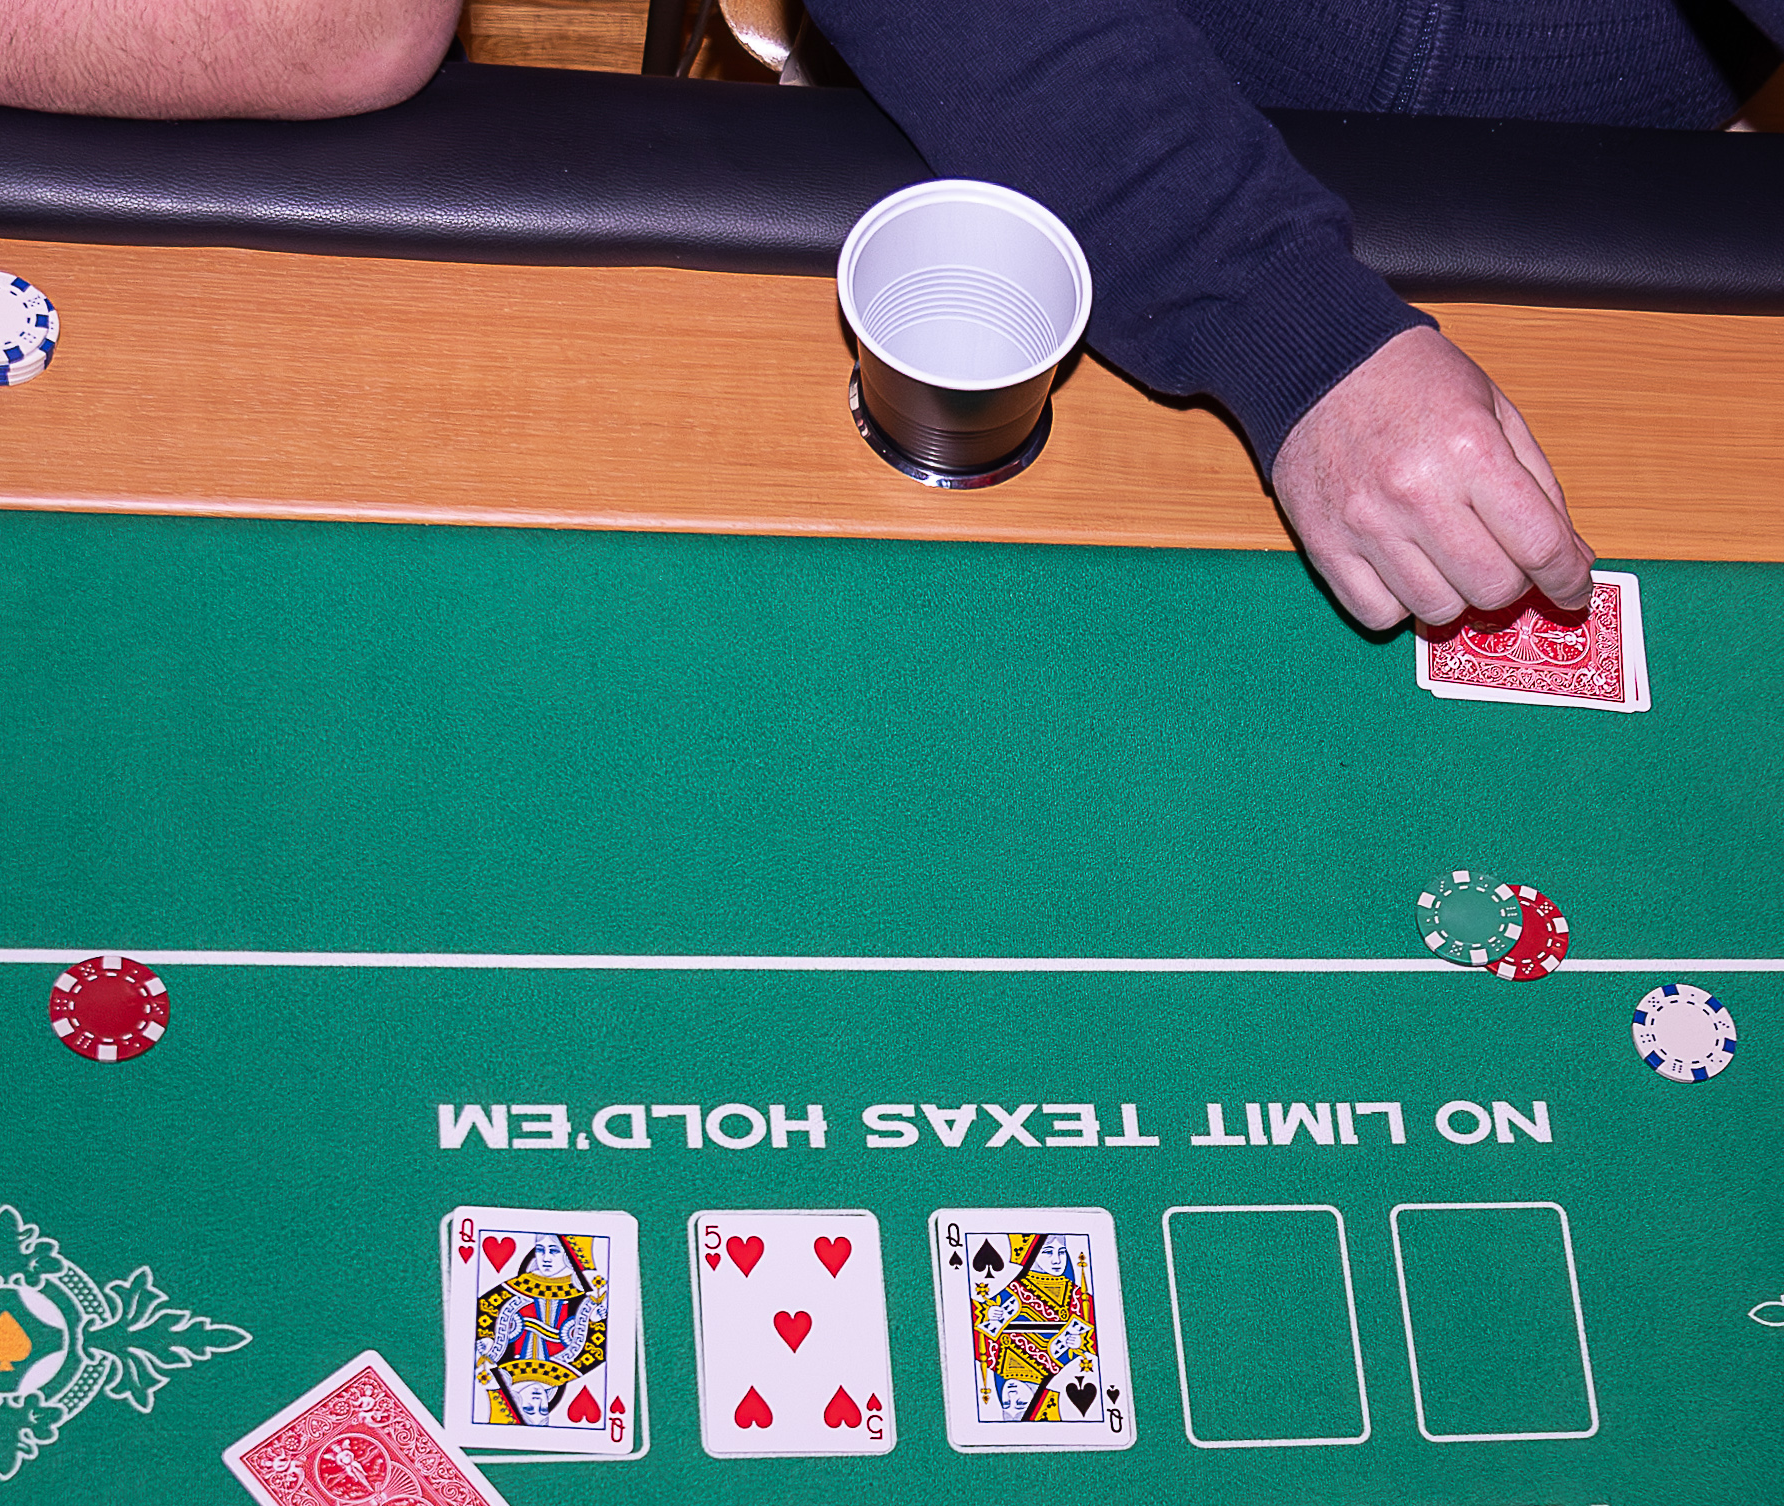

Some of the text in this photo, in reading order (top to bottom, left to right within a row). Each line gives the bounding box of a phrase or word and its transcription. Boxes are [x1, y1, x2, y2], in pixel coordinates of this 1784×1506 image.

[437, 1100, 1553, 1150] NO LIMIT TEXAS HOLD'EM
[459, 1218, 475, 1243] Q
[705, 1225, 722, 1250] 5
[946, 1223, 963, 1248] Q
[609, 1417, 625, 1443] Q
[866, 1414, 884, 1440] 5
[1107, 1408, 1123, 1434] Q
